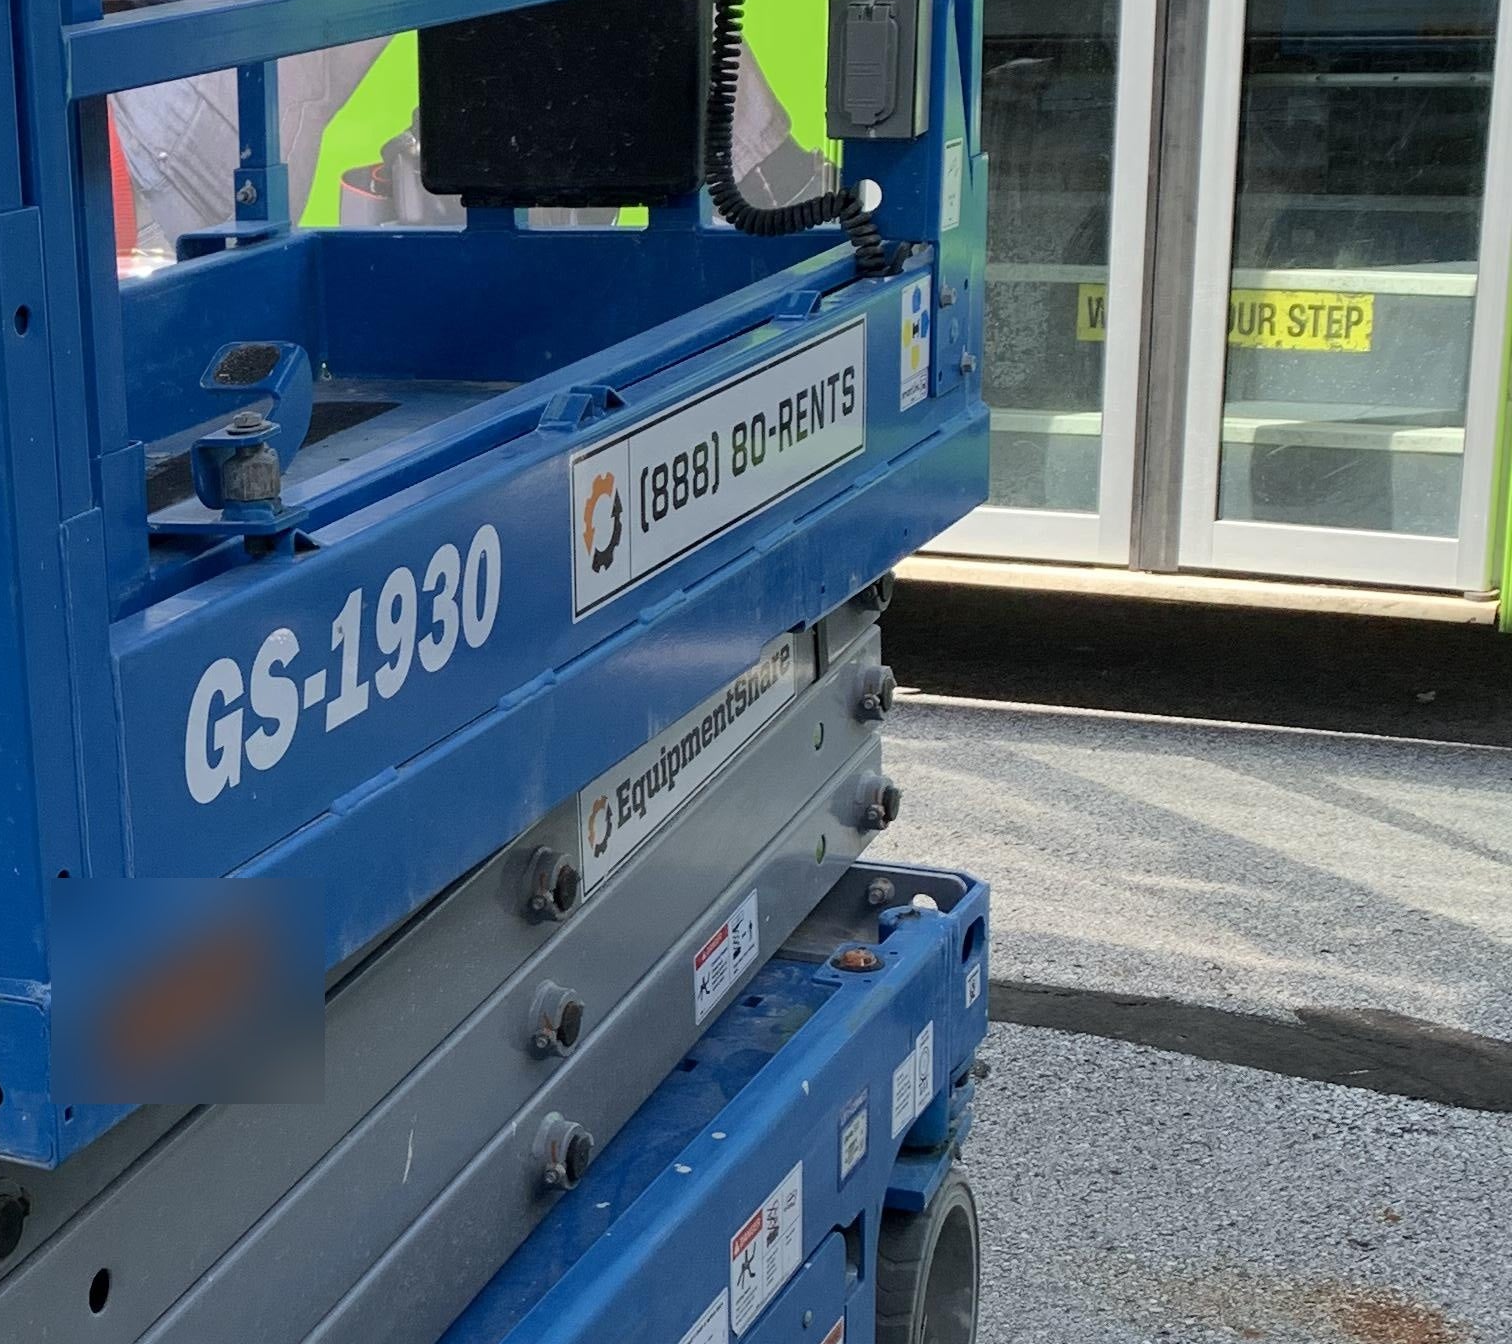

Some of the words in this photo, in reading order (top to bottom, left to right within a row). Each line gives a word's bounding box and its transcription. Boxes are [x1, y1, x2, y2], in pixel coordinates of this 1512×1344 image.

[1287, 303, 1364, 339] STEP
[640, 431, 719, 533] (888)
[732, 366, 854, 477] 80-RENTS
[185, 524, 501, 804] GS-1930
